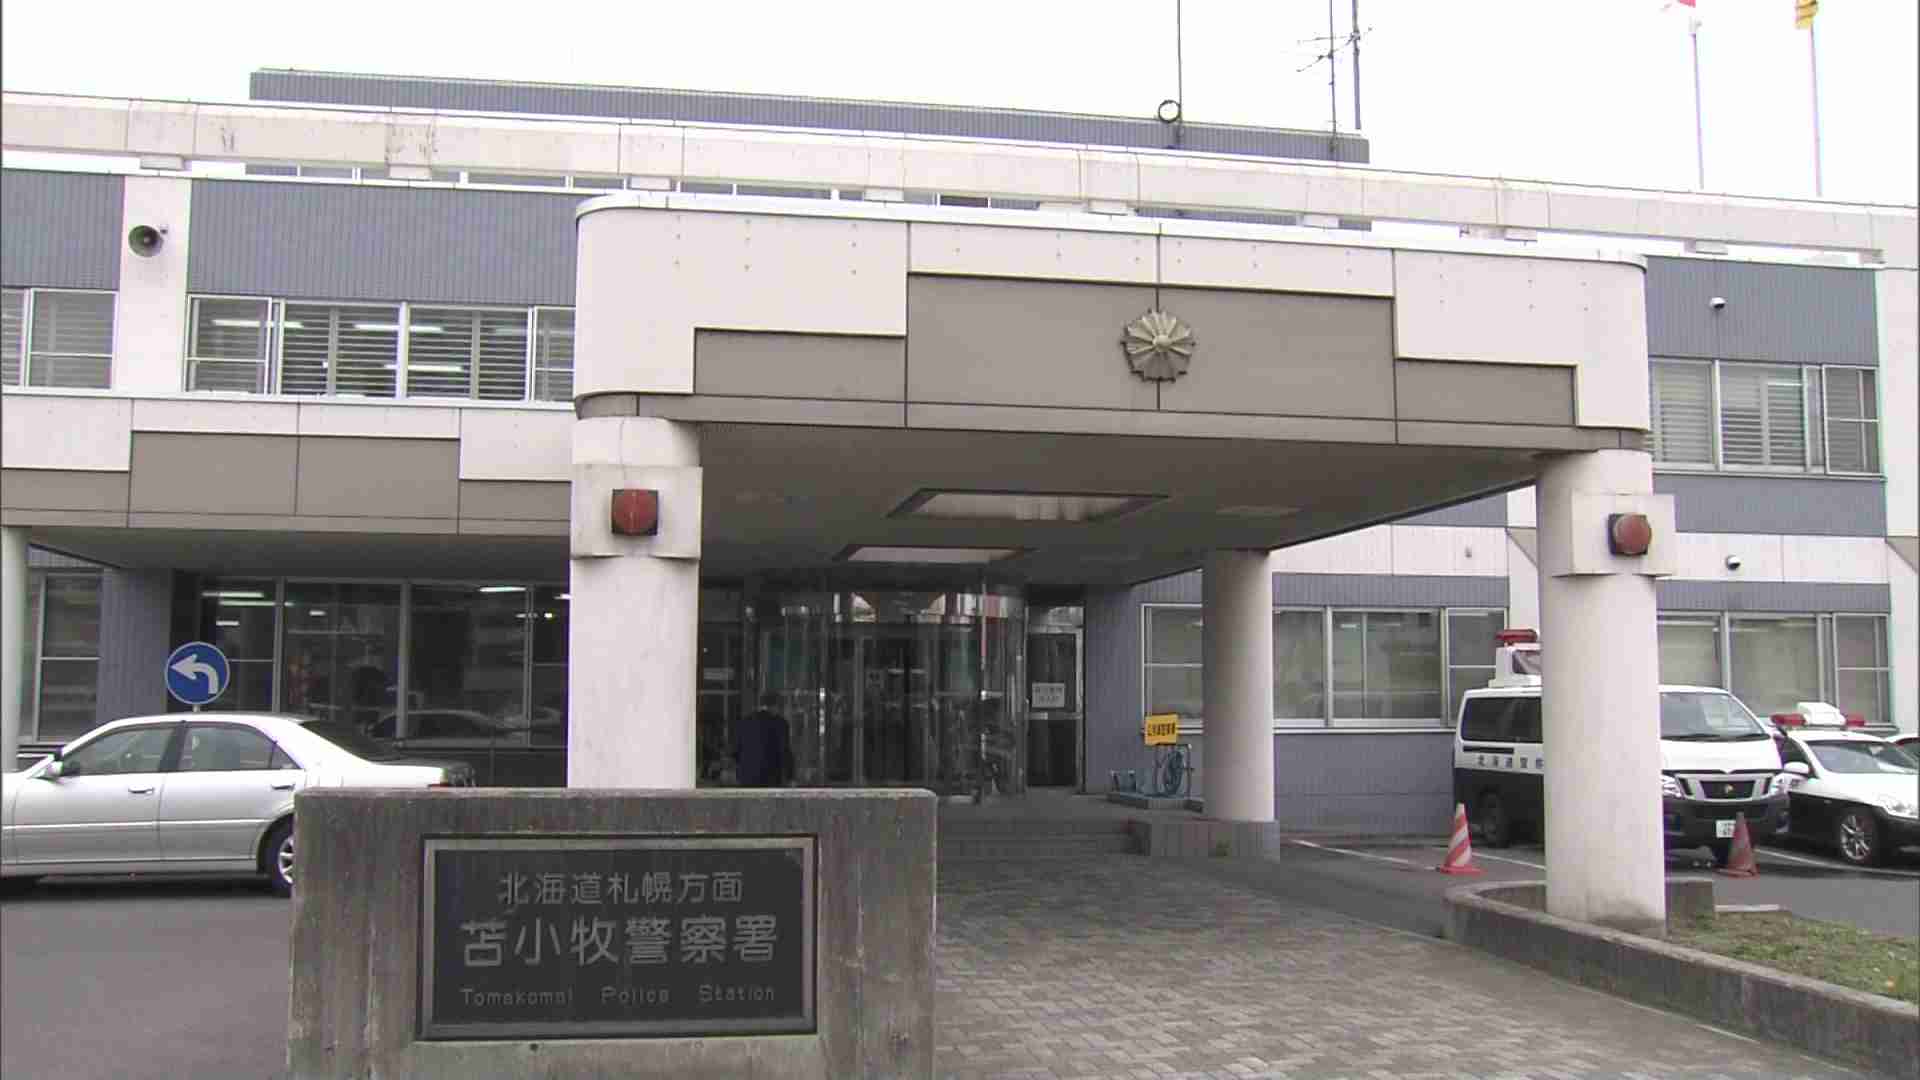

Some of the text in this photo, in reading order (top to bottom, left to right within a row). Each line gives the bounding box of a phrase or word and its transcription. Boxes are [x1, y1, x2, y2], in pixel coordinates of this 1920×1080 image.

[500, 871, 744, 905] 北海道札幌方面
[460, 913, 777, 967] 苫小牧警察署
[601, 985, 669, 1003] Police
[699, 984, 775, 1001] Station
